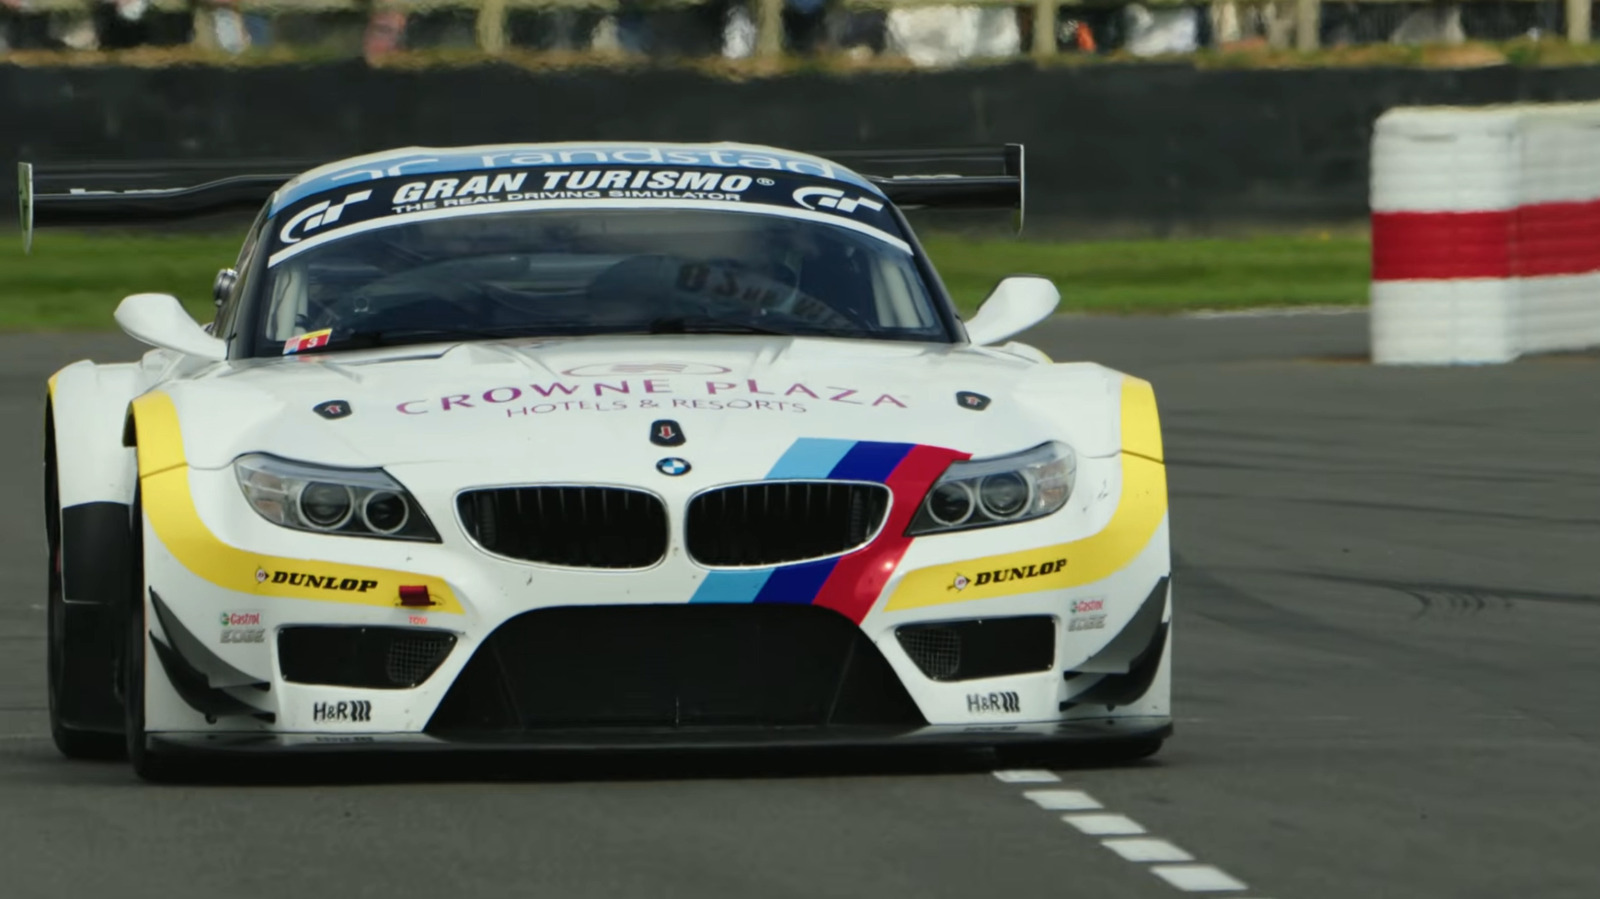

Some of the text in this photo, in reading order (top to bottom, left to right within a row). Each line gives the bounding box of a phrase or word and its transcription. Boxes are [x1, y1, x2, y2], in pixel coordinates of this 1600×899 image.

[482, 147, 836, 180] randstad
[392, 172, 527, 205] GRAN
[392, 190, 741, 214] THE REAL DRIVING SIMULATOR
[396, 379, 908, 415] CROWNE PLAZA
[507, 398, 807, 417] HOTELS & RESORTS
[271, 571, 378, 593] DUNLOP
[974, 558, 1067, 587] DUNLOP
[230, 612, 260, 625] Castrol
[1076, 600, 1105, 614] Castrol
